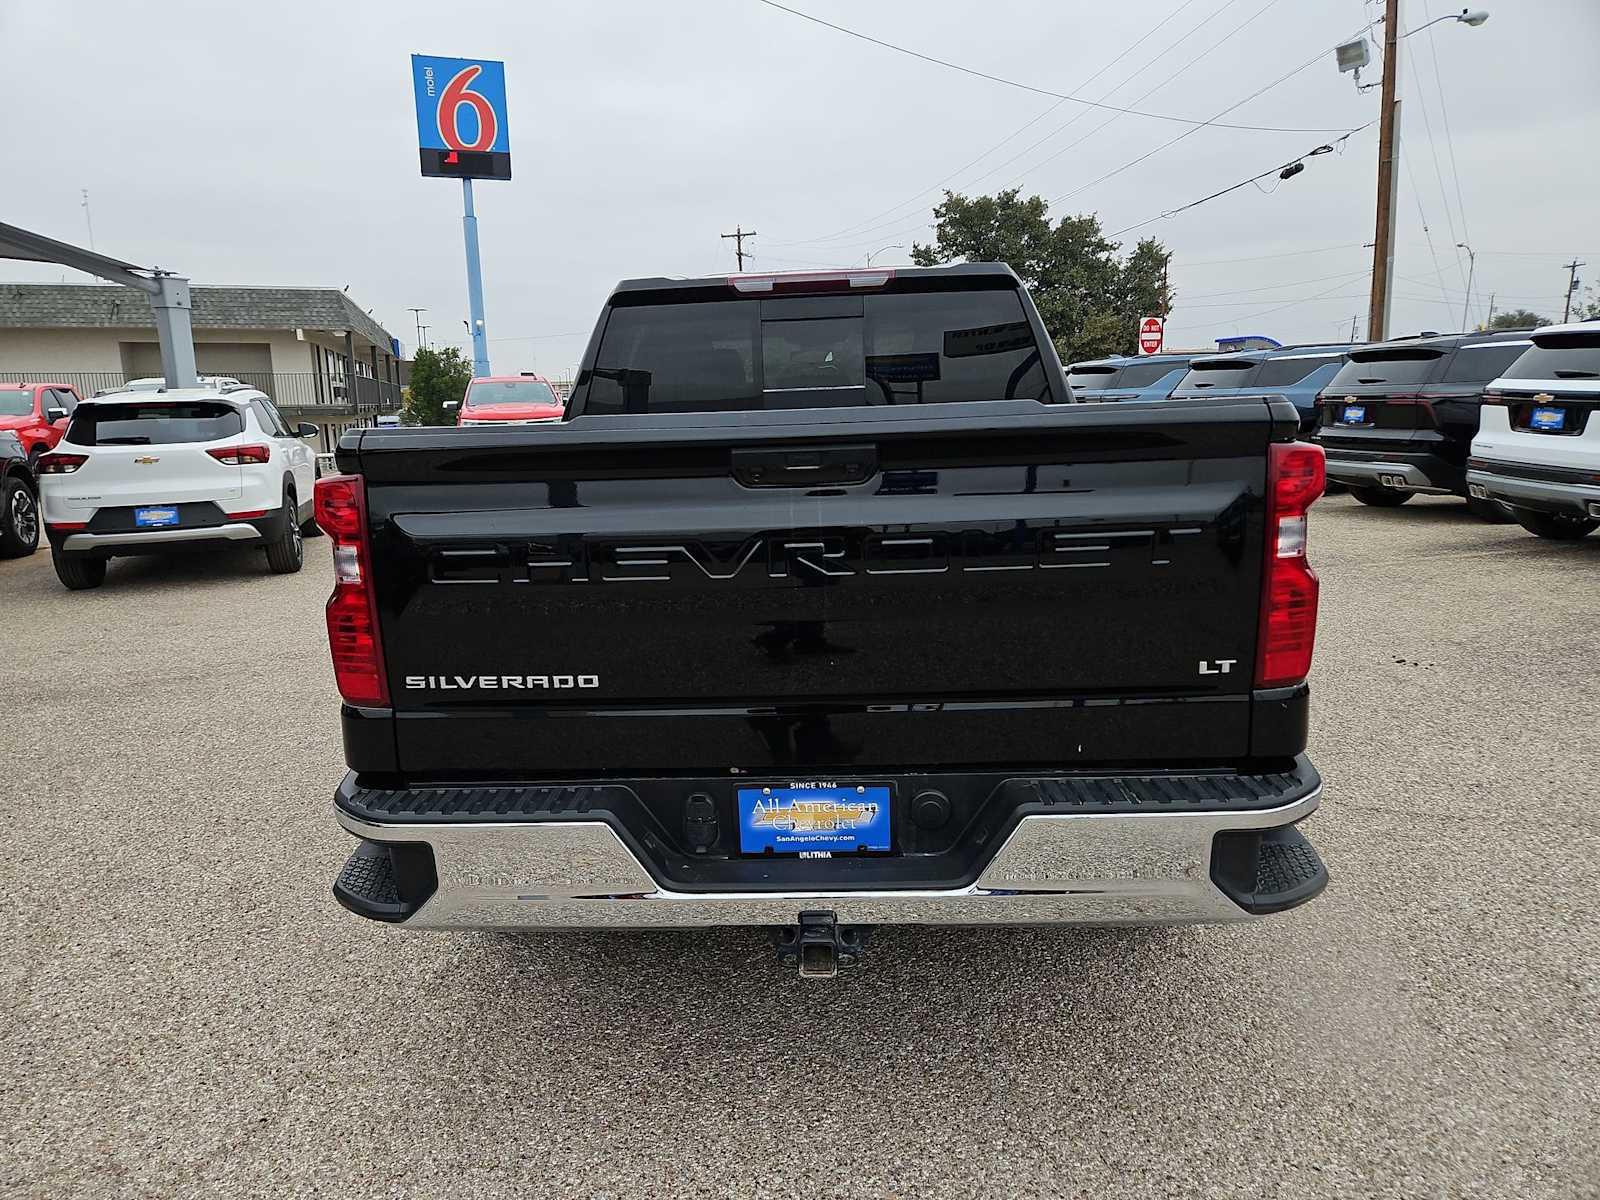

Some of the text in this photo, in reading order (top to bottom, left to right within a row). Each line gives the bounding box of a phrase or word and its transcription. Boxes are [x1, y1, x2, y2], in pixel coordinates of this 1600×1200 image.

[437, 64, 498, 152] 6
[430, 528, 1203, 583] CHEVROLET
[1198, 659, 1237, 675] LT
[405, 674, 599, 690] SILVERADO
[752, 798, 879, 814] All American
[772, 814, 857, 831] Chevrolet
[776, 835, 855, 843] SanAngeloChevy.com
[806, 851, 831, 859] LITHIA
